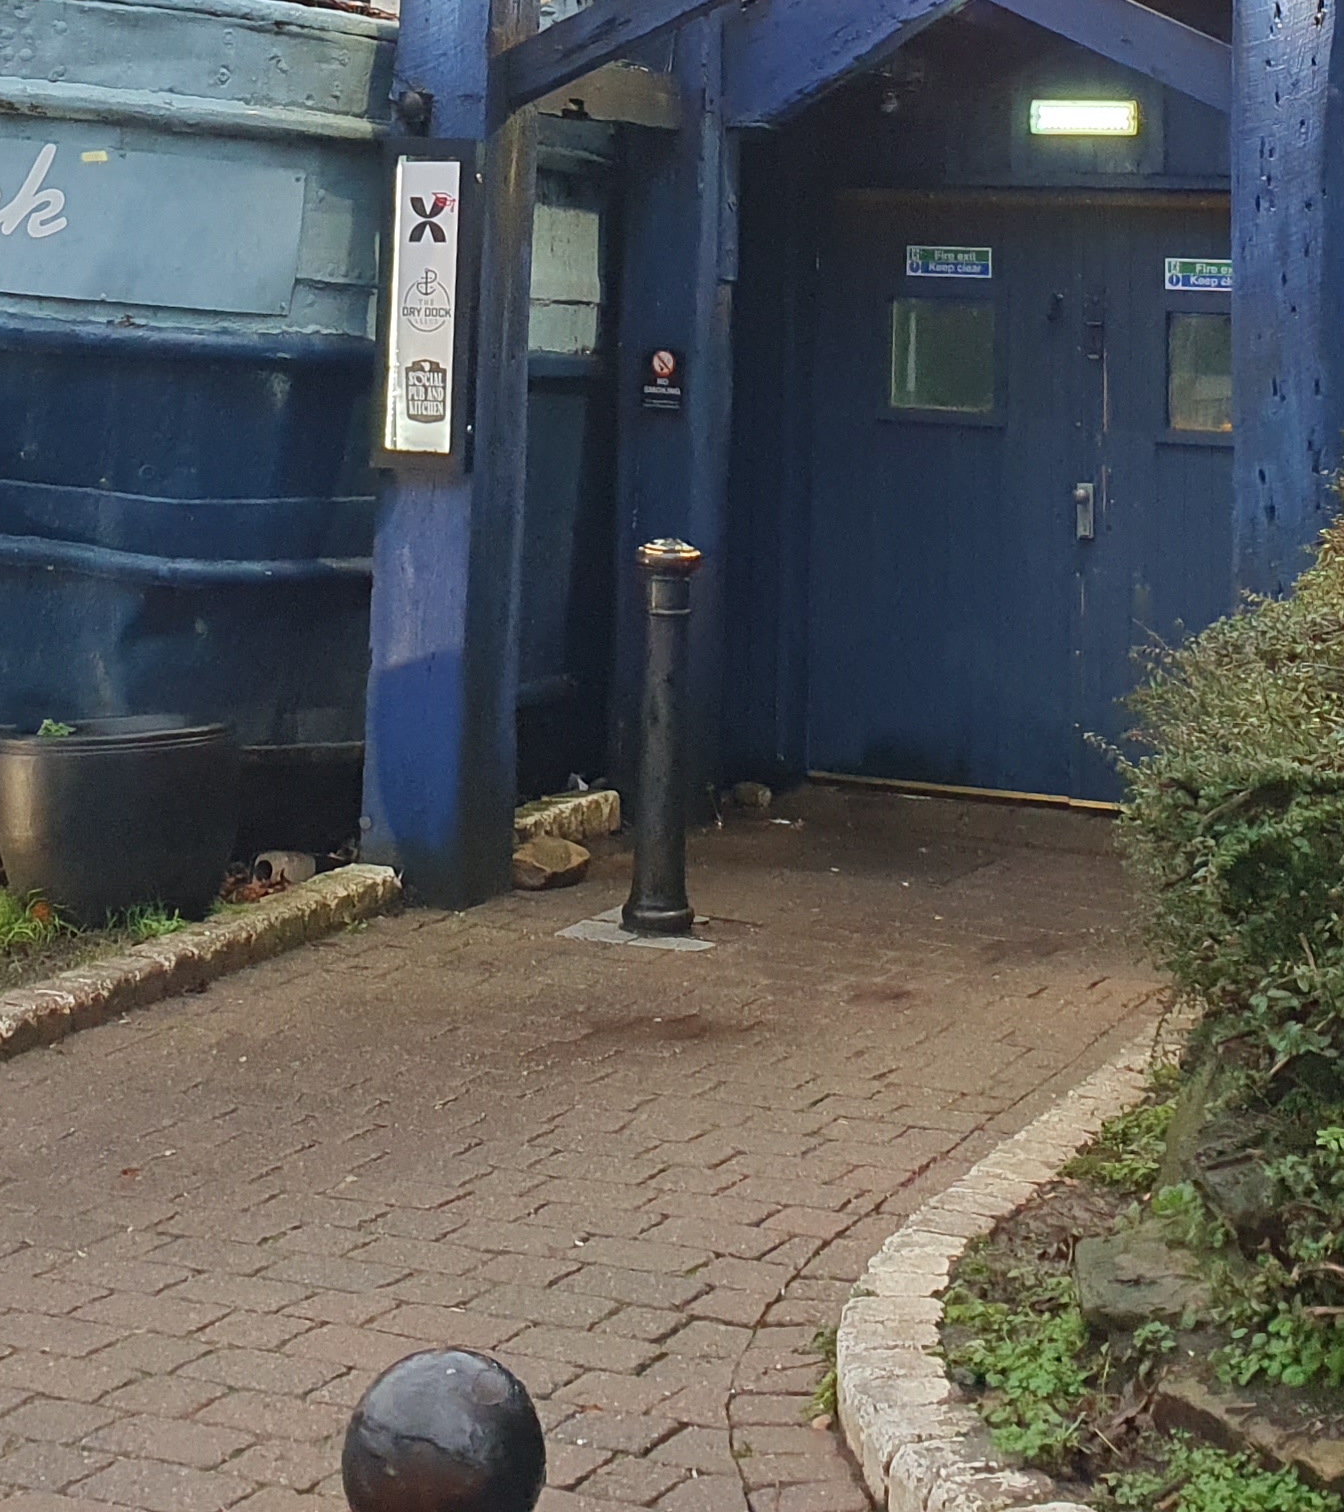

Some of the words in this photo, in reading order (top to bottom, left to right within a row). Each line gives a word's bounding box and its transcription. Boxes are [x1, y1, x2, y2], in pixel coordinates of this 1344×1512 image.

[934, 250, 955, 261] Fire
[957, 251, 976, 262] exit
[928, 263, 955, 274] Keep
[957, 263, 982, 273] clear
[1195, 263, 1218, 274] Fire
[1189, 274, 1218, 287] Keep
[418, 298, 435, 306] THE
[402, 306, 422, 317] DRY
[424, 307, 452, 318] DOCK
[408, 371, 444, 387] SOCIAL
[408, 386, 426, 401] PUB
[426, 387, 445, 402] AND
[408, 400, 444, 416] KITCHEN
